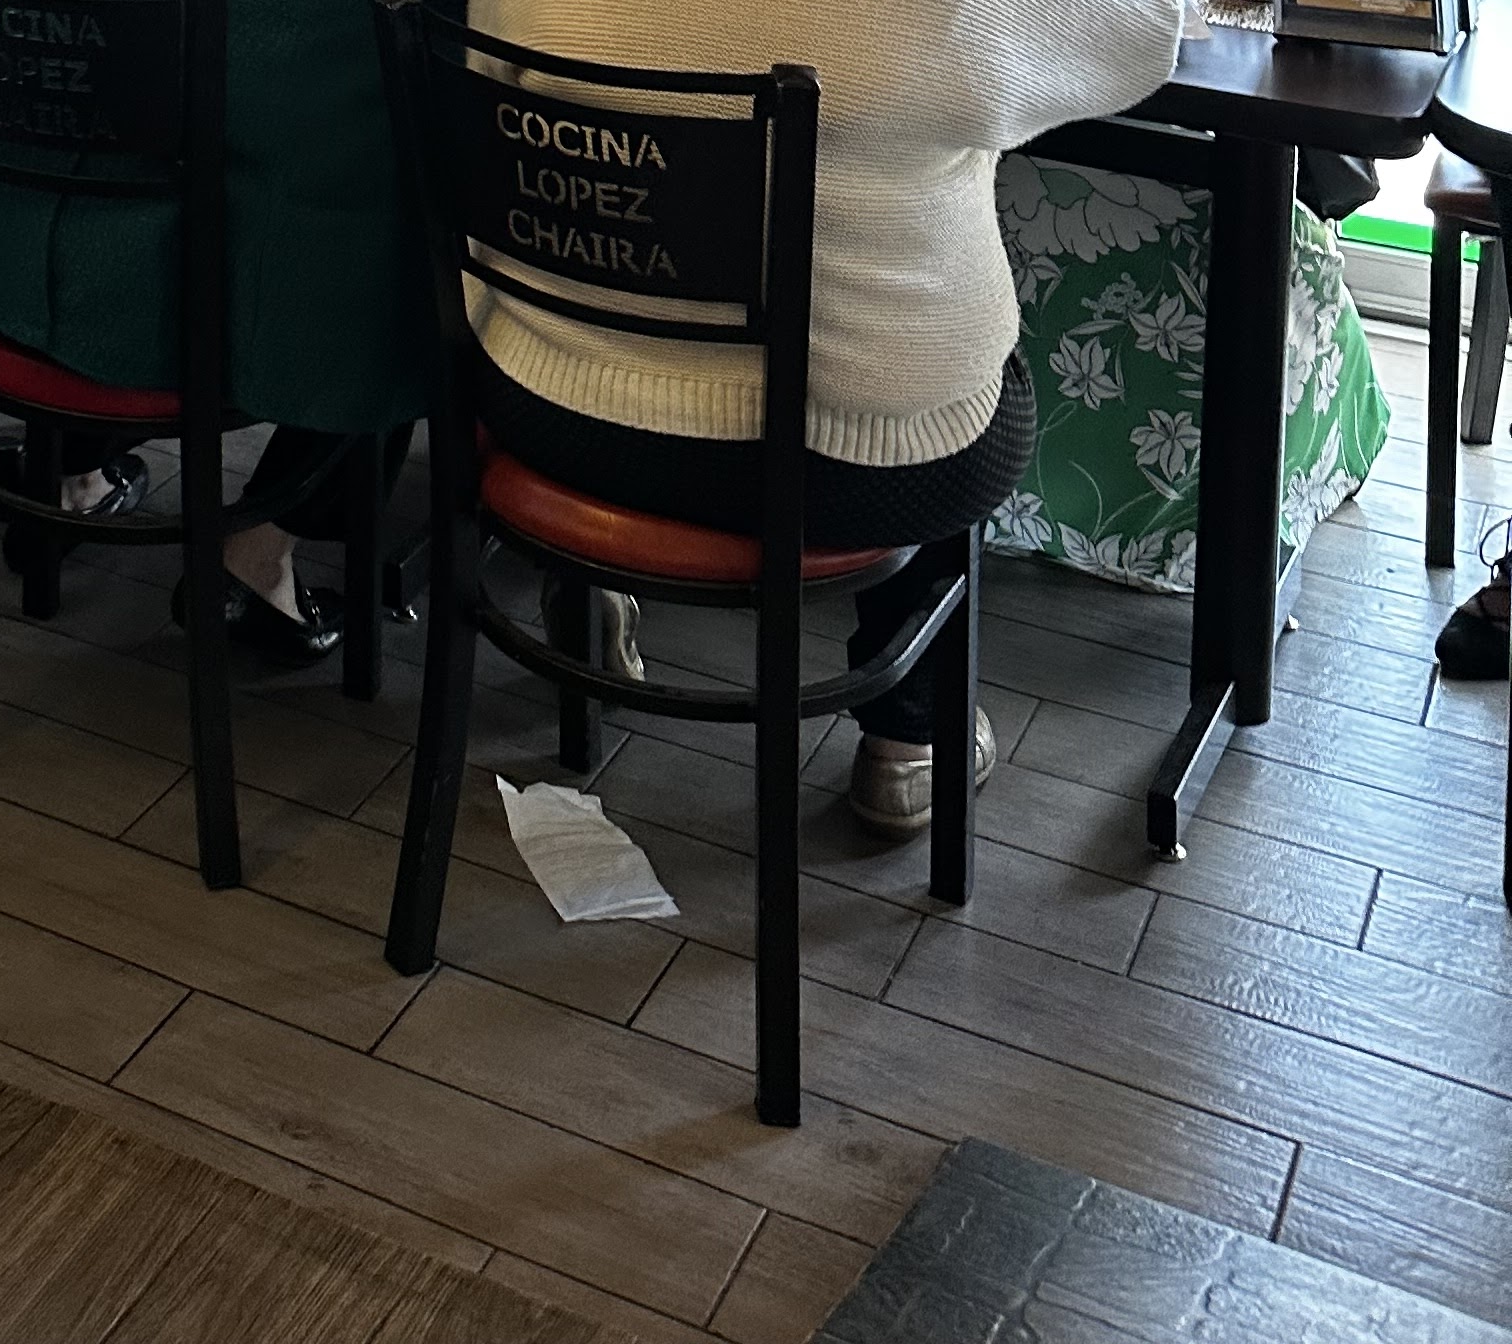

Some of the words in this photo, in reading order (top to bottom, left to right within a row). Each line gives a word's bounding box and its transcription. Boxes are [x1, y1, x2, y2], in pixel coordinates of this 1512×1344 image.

[496, 103, 667, 171] COCINA
[517, 159, 654, 223] LOPEZ
[508, 208, 677, 279] CHAIRA
